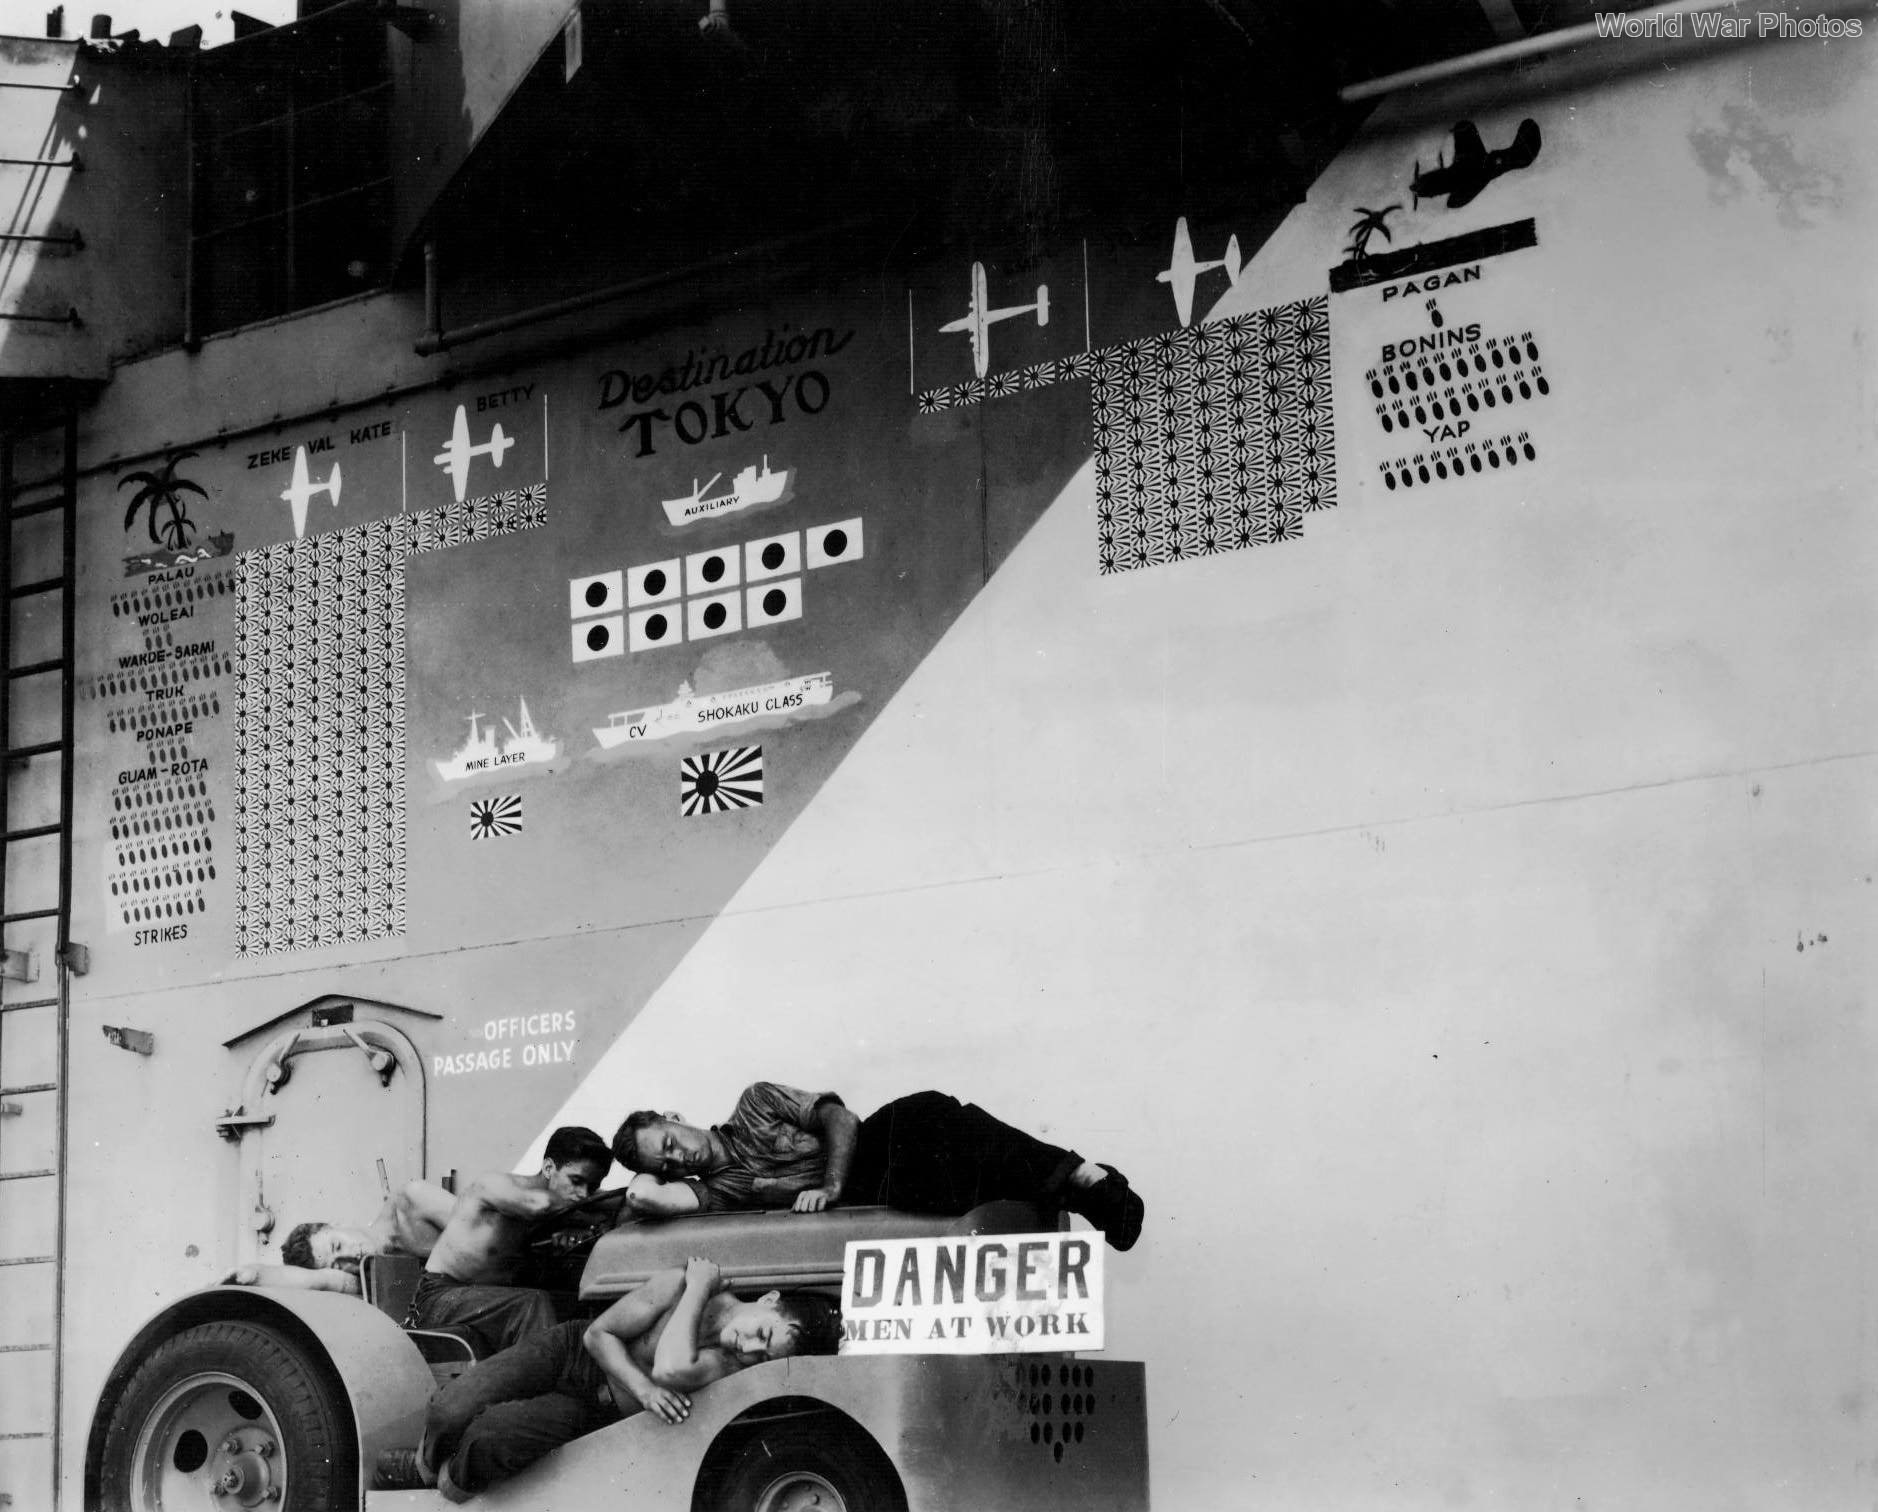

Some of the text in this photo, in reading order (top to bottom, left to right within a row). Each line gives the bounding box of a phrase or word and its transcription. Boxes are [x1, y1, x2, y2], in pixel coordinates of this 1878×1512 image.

[1382, 265, 1482, 302] PAGAN
[1382, 323, 1482, 363] BONINS
[600, 322, 856, 411] Destination
[476, 382, 535, 413] BETTY
[619, 370, 831, 458] TOKYO
[247, 420, 392, 470] ZEKE VAL KATE
[1423, 420, 1471, 445] YAP
[684, 496, 741, 517] AUXILIARY
[147, 566, 195, 585] PALAU
[138, 605, 194, 628] WOLEAI
[118, 640, 215, 669] WAKDE-SARMI
[146, 684, 184, 702] TRUK
[697, 693, 803, 723] SHOKAKU CLASS
[136, 721, 193, 743] PONAPE
[629, 724, 647, 739] CV
[465, 752, 525, 772] MINE LAYER
[134, 924, 188, 946] STRIKES
[484, 1009, 577, 1041] OFFICERS
[433, 1039, 575, 1077] PASSAGE ONLY
[851, 1239, 1092, 1308] DANGER
[844, 1312, 1091, 1342] MEN AT WORK
